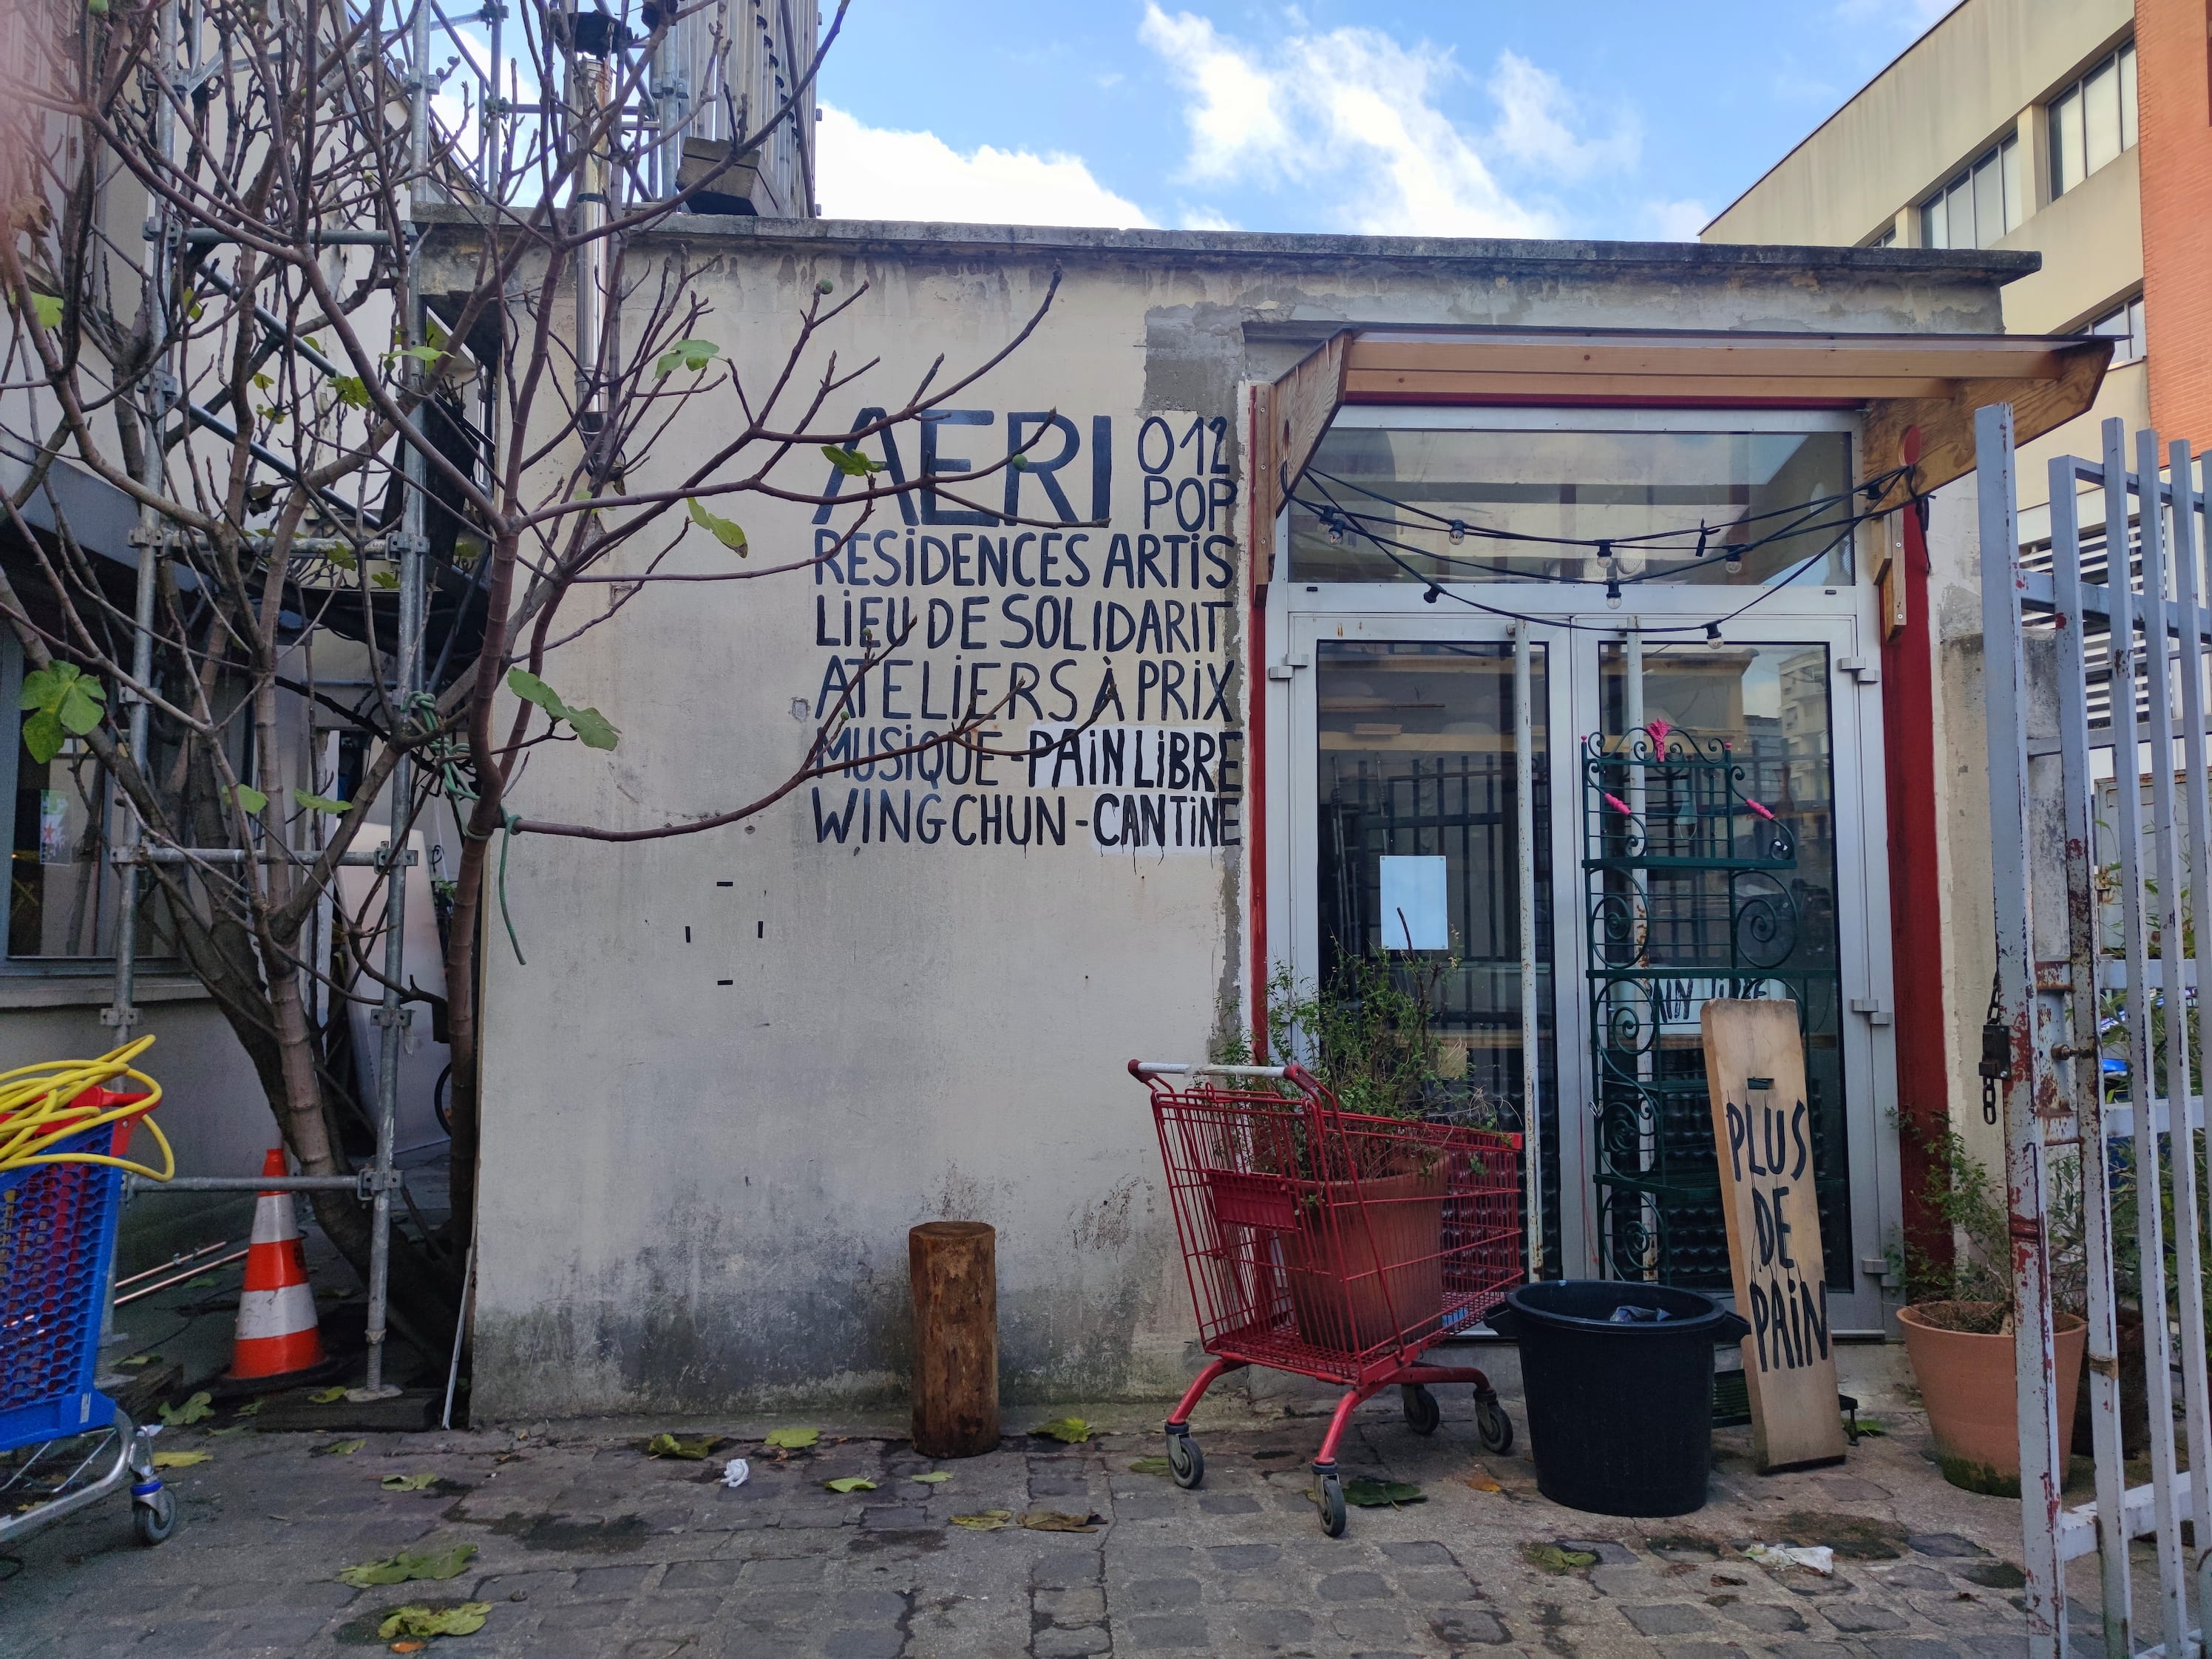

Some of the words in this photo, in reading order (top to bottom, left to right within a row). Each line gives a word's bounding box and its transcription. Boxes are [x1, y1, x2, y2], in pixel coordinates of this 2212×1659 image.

[812, 407, 1112, 526] AERI
[1138, 416, 1230, 475] 012
[1144, 475, 1238, 532] POP
[927, 596, 990, 650] DE
[1001, 594, 1233, 654] SOLIDARIT
[1097, 656, 1125, 721] À
[1726, 1099, 1806, 1181] PLUS
[1751, 1186, 1794, 1269] DE
